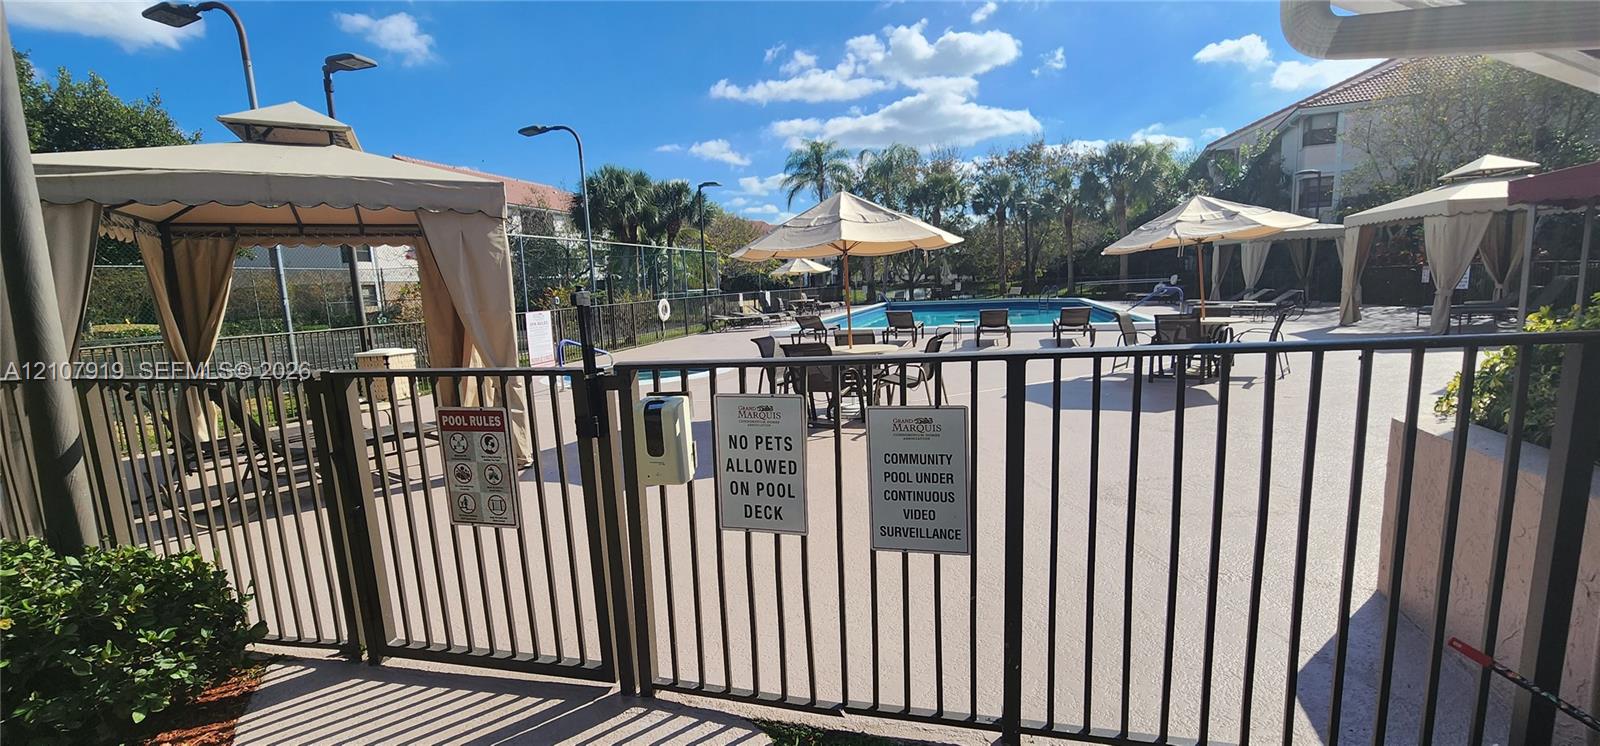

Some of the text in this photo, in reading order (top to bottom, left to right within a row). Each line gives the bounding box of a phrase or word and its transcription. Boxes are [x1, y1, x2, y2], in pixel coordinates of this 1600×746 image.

[442, 415, 502, 427] POOL RULES
[738, 410, 782, 420] MARQUIS
[892, 423, 942, 434] MARQUIS
[728, 434, 793, 452] NO PETS
[883, 452, 953, 466] COMMUNITY
[725, 457, 798, 476] ALLOWED
[883, 472, 955, 485] POOL UNDER
[729, 480, 796, 499] ON POOL
[883, 490, 956, 504] CONTINUOUS
[743, 503, 784, 521] DECK
[902, 508, 936, 521] VIDEO
[879, 525, 962, 541] SURVEILLANCE
